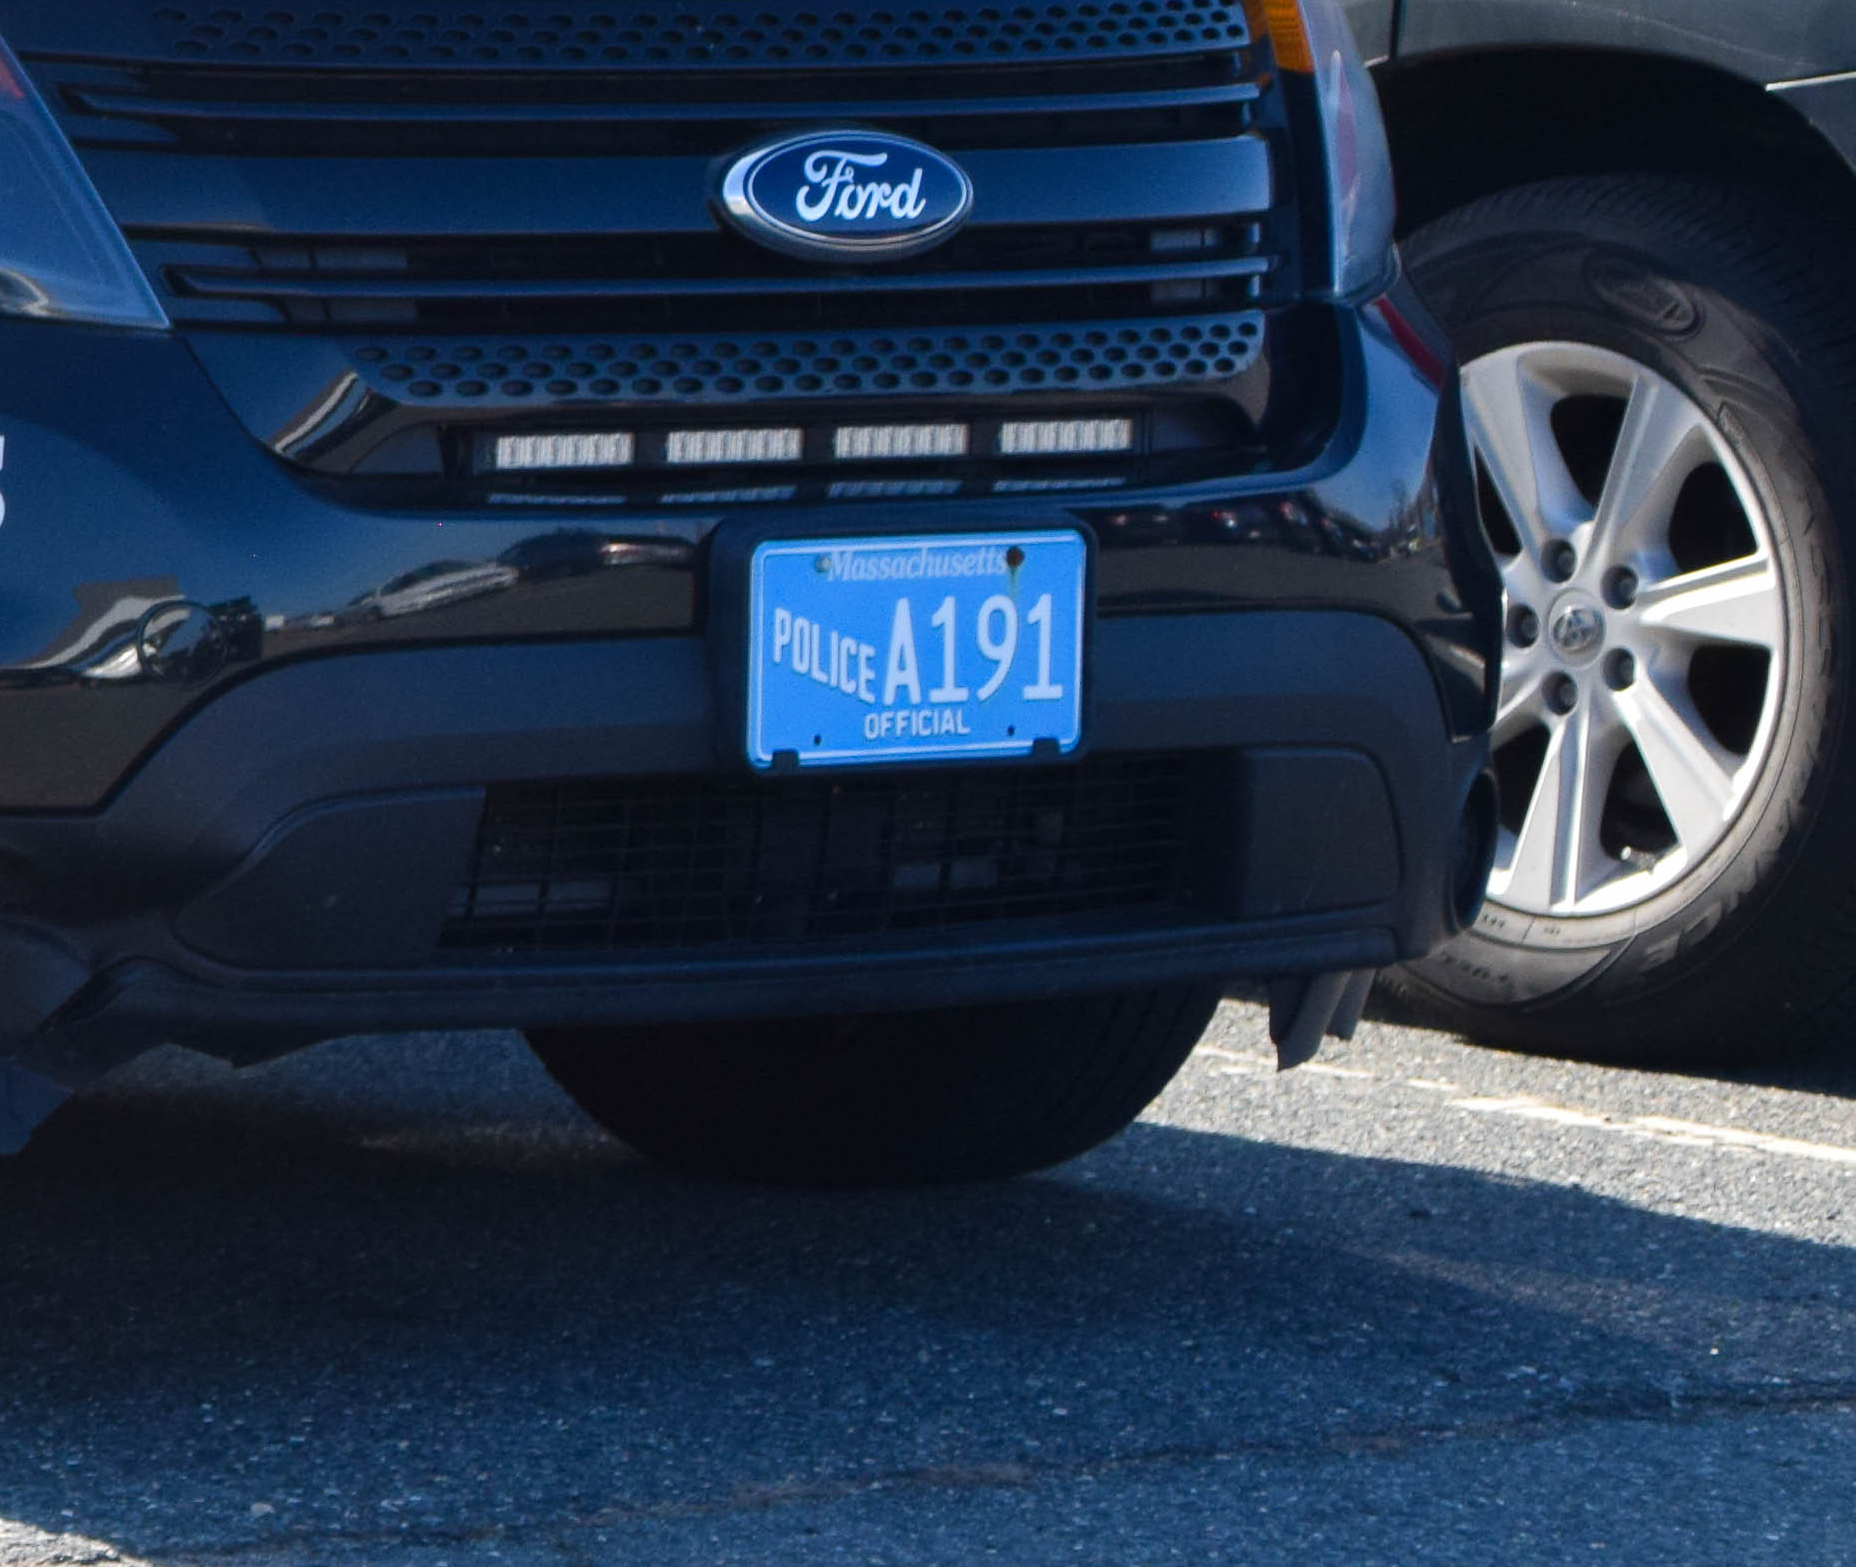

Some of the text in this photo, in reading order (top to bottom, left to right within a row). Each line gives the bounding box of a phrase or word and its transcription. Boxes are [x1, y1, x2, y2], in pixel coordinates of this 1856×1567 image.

[796, 149, 927, 222] Ford
[827, 546, 1008, 583] Massachusetts
[773, 593, 1064, 706] POLICE A191
[864, 707, 970, 741] OFFICIAL
